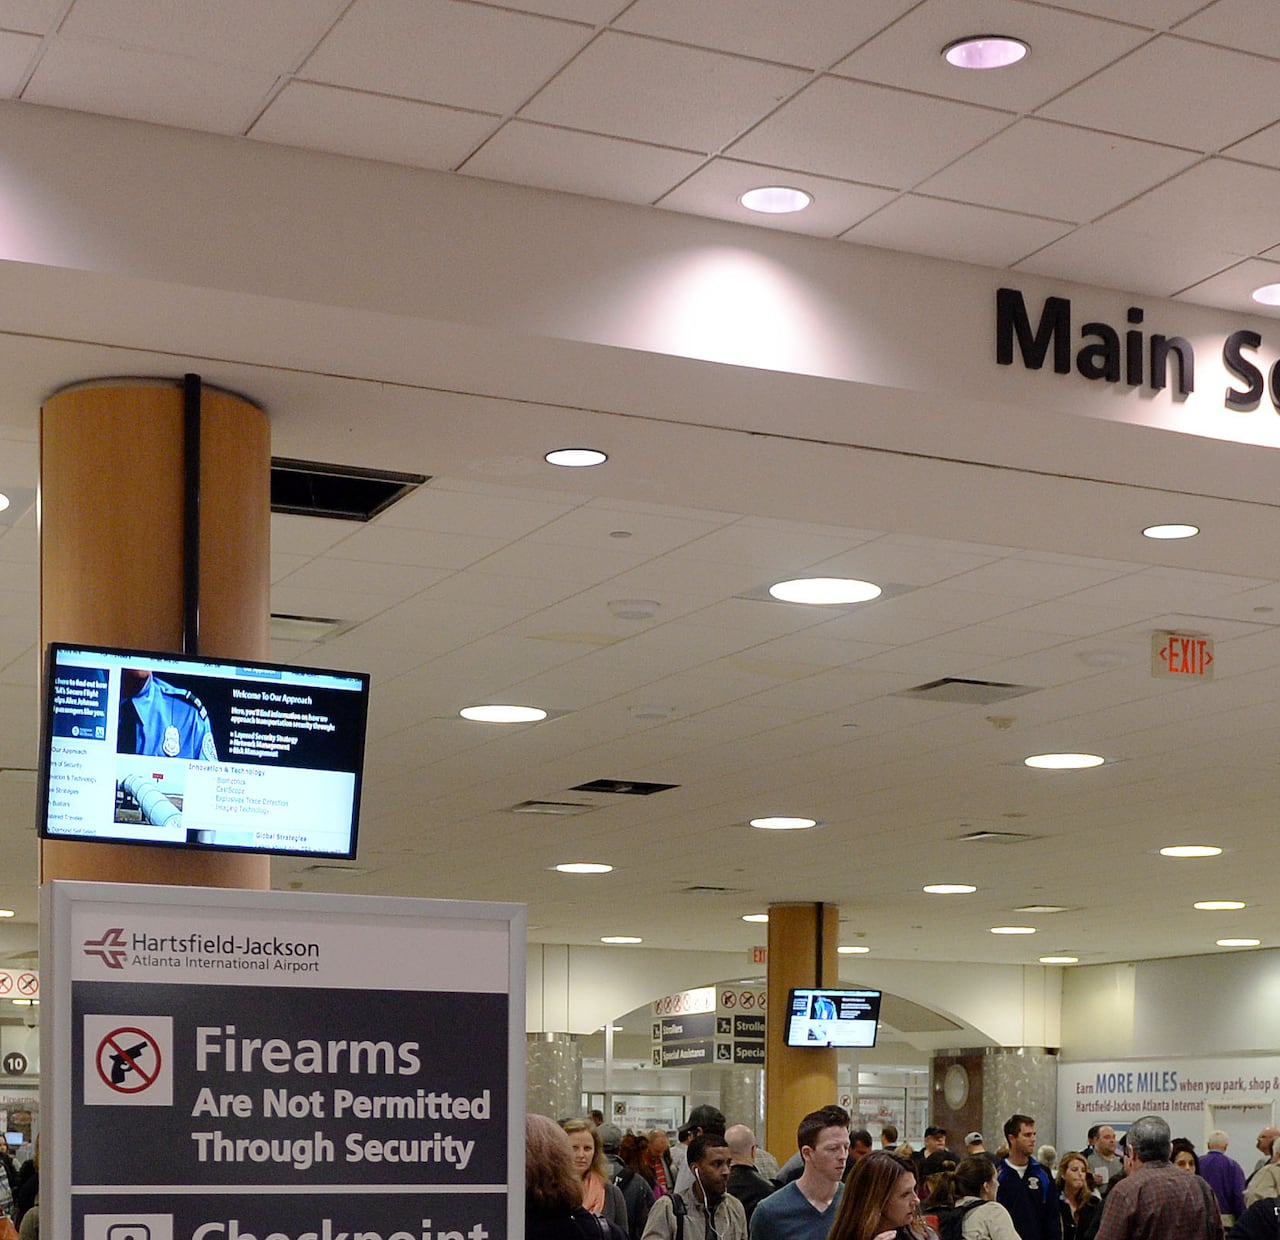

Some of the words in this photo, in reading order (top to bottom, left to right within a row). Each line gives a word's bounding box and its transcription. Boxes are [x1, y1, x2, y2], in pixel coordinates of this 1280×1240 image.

[996, 288, 1194, 396] Main
[1169, 637, 1206, 675] EXIT
[232, 689, 261, 700] Welcome
[261, 692, 270, 700] To
[270, 693, 282, 702] Our
[282, 694, 313, 705] Approach
[132, 933, 320, 957] Hartsfield-Jackson
[132, 955, 181, 967] Atlanta
[186, 957, 270, 970] International
[273, 958, 320, 973] Airport
[736, 1022, 765, 1031] Strolle
[195, 1025, 421, 1076] Firearms
[736, 1047, 765, 1059] Specia
[7, 1058, 23, 1070] 10
[1076, 1082, 1094, 1094] Earn
[1096, 1072, 1133, 1094] MORE
[1137, 1071, 1177, 1093] MILES
[1179, 1079, 1203, 1091] when
[1205, 1081, 1221, 1093] you
[1249, 1077, 1270, 1093] shop
[1272, 1077, 1280, 1089] &
[192, 1088, 253, 1118] Are
[263, 1089, 324, 1119] Not
[334, 1089, 491, 1120] Permitted
[1076, 1099, 1141, 1112] Hartsfield-Jackson
[1142, 1099, 1170, 1112] Atlanta
[1171, 1099, 1206, 1111] Internat
[192, 1131, 335, 1169] Through
[345, 1133, 475, 1169] Security
